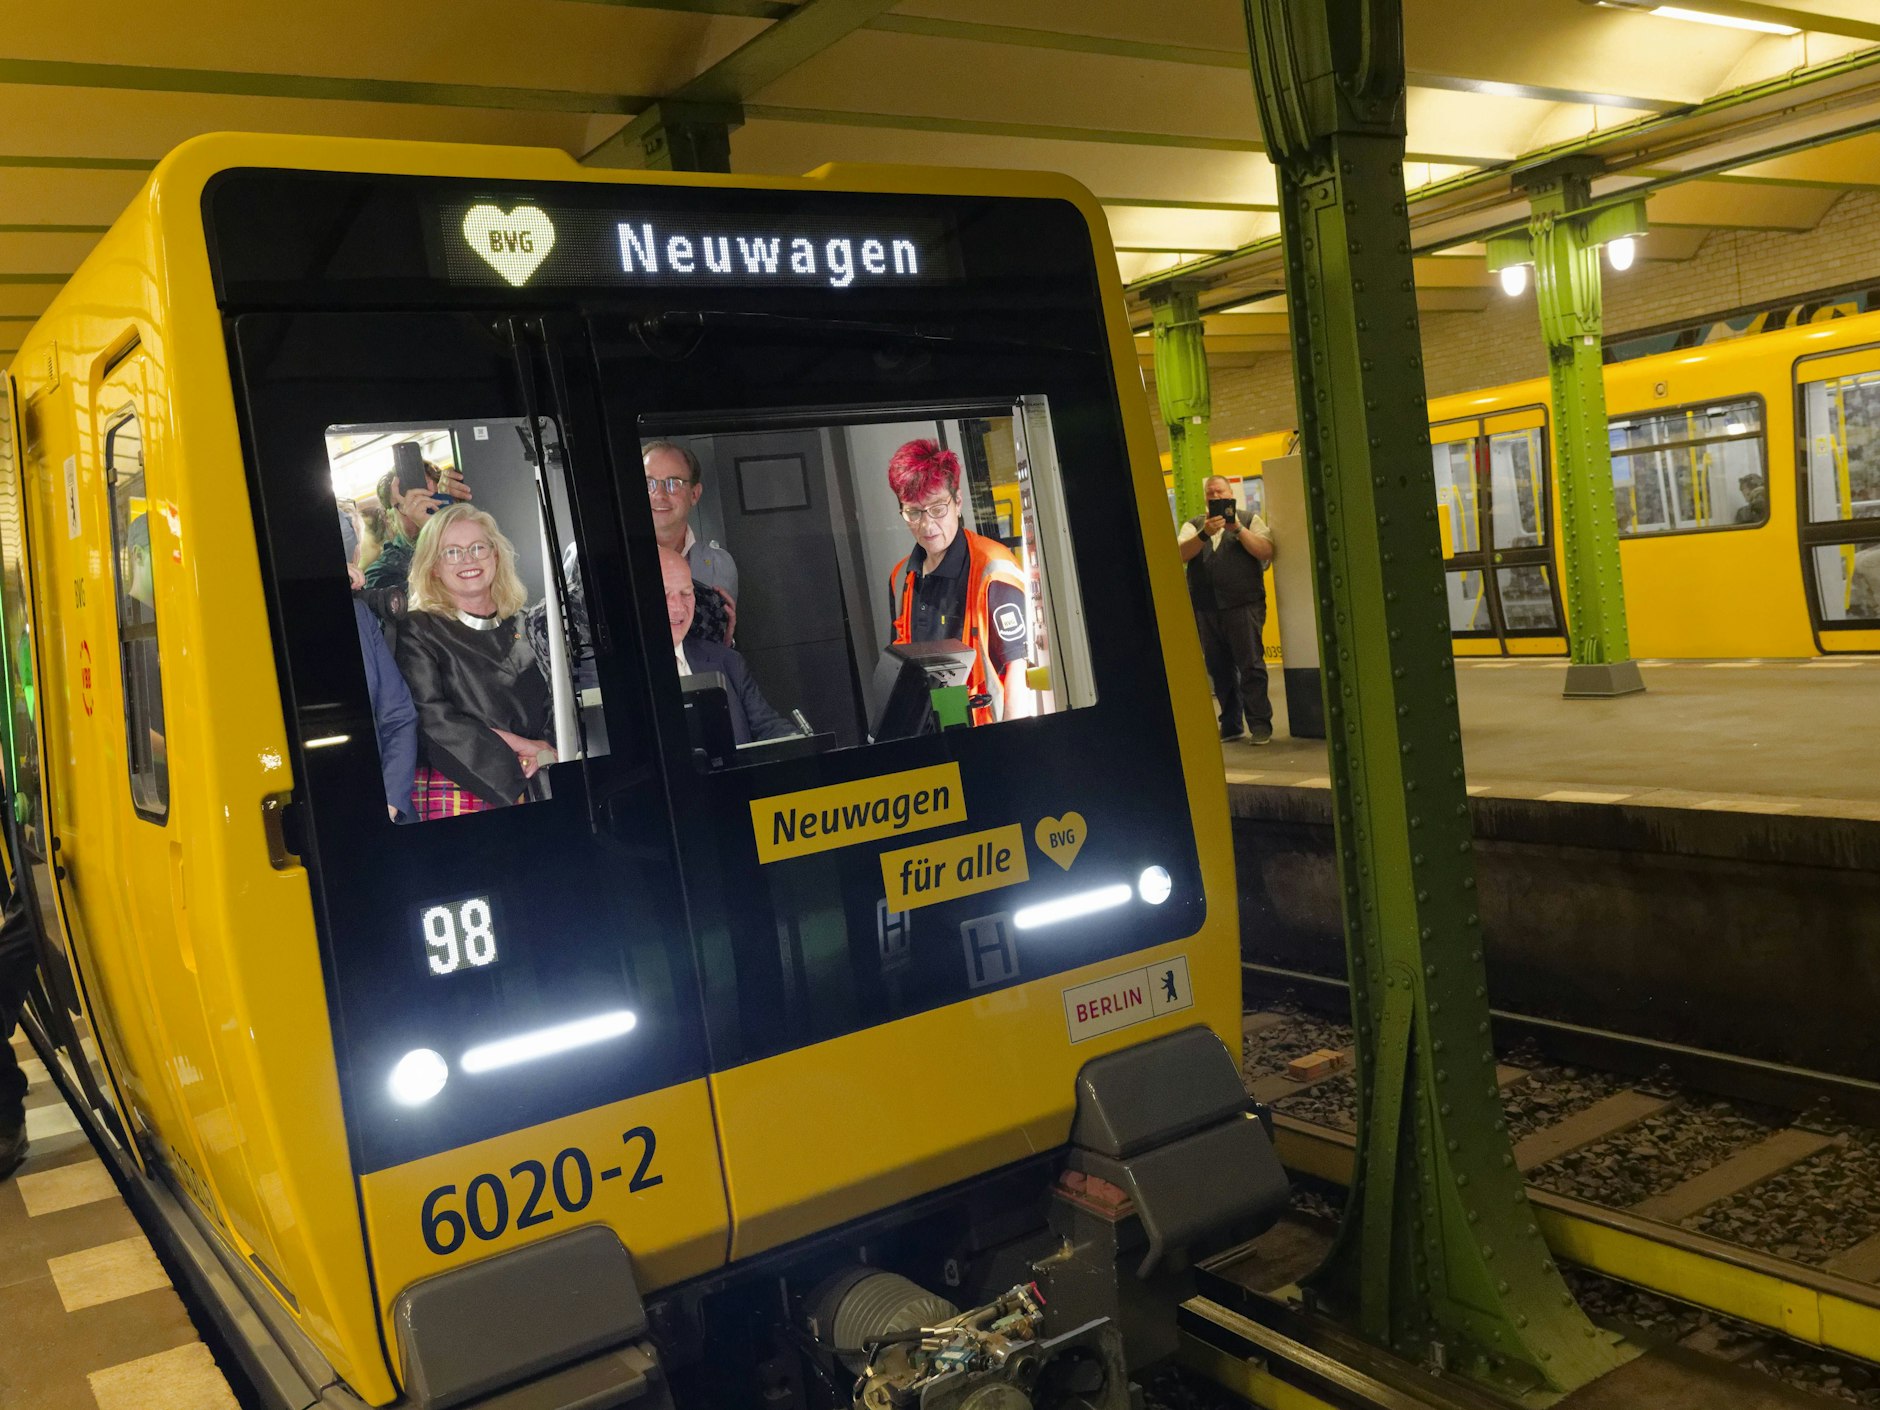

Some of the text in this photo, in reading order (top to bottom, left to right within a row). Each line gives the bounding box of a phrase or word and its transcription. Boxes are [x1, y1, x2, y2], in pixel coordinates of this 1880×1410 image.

[489, 230, 534, 253] BVG
[617, 222, 918, 288] Neuwagen
[772, 785, 950, 846] Neuwagen
[1049, 828, 1076, 849] BVG
[900, 842, 1012, 896] für alle
[422, 898, 497, 975] 98
[968, 920, 1013, 982] H
[1076, 986, 1143, 1023] BERLIN
[421, 1125, 664, 1256] 6020-2
